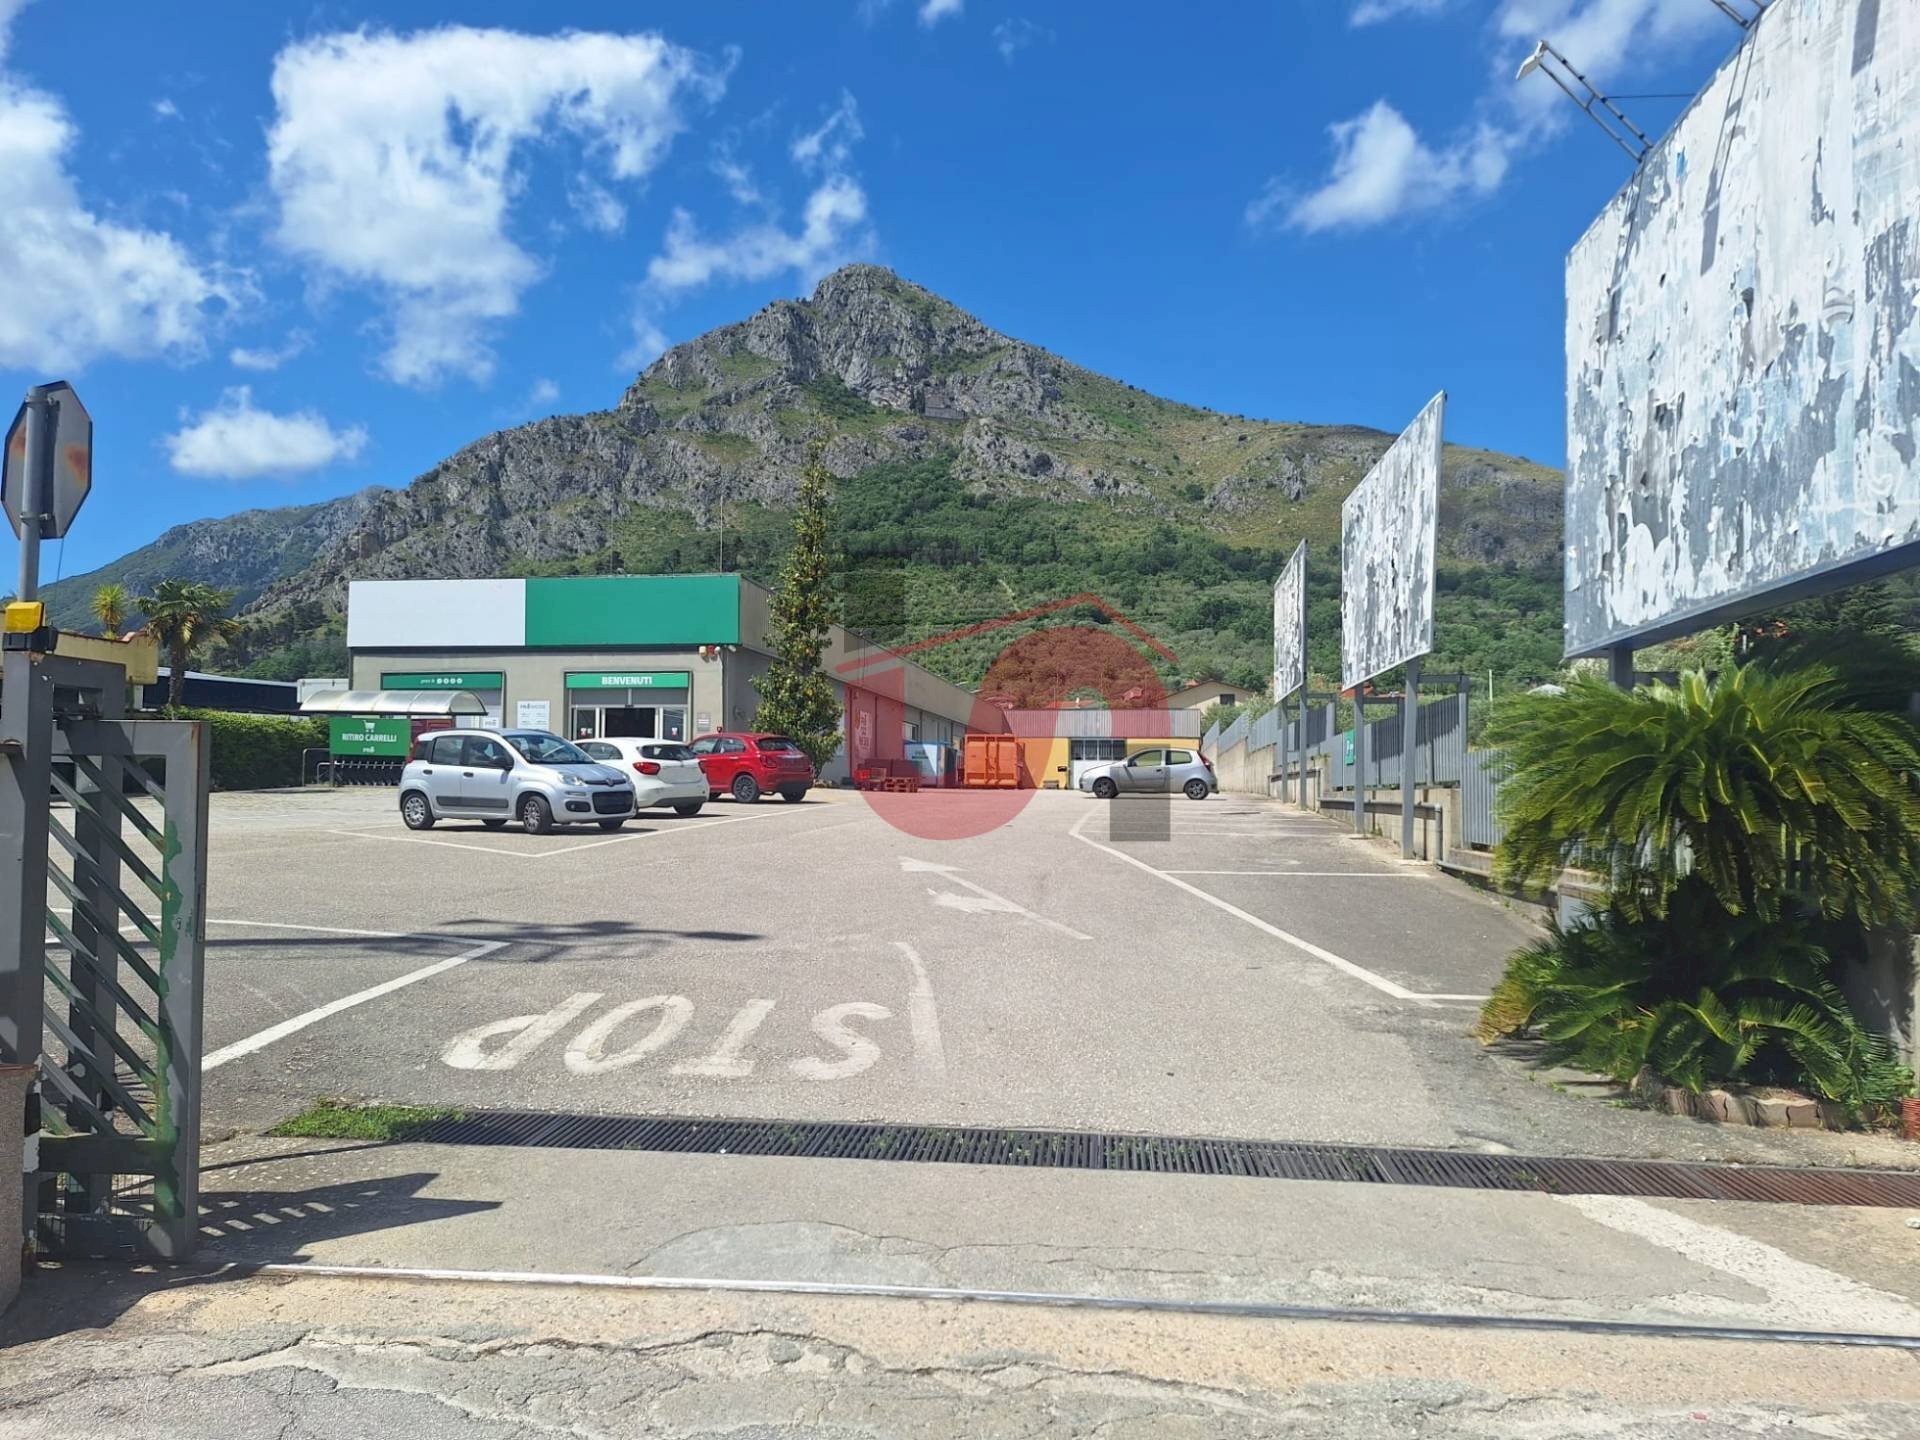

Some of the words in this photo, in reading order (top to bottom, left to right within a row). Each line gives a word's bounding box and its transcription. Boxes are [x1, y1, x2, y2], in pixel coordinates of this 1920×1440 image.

[601, 676, 652, 685] BENVENUTI
[342, 733, 364, 742] RITIRO
[365, 733, 398, 742] CARRELLI
[441, 992, 891, 1080] STOP
